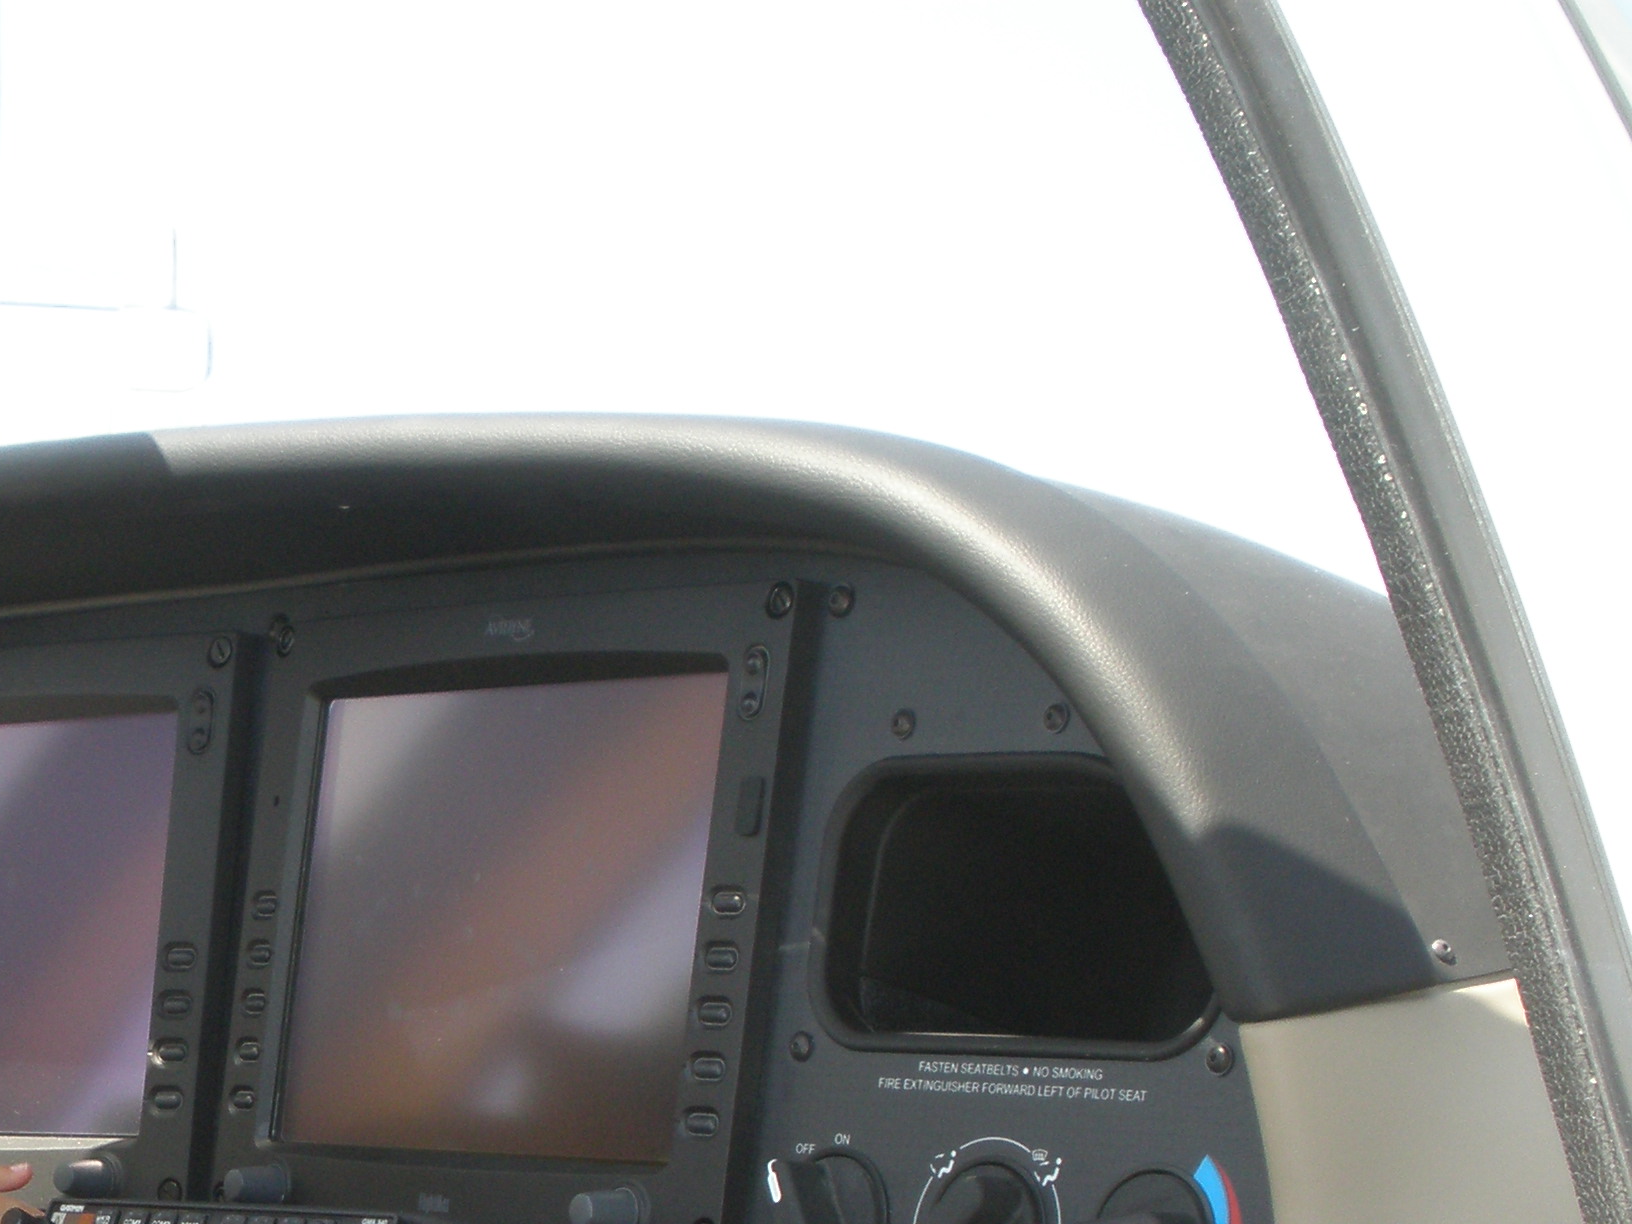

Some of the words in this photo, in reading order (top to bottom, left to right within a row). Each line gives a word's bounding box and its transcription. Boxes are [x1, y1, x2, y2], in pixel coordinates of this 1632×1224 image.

[918, 1060, 959, 1074] FASTEN
[960, 1062, 1020, 1077] SEATBELTS
[1032, 1065, 1049, 1078] NO
[1051, 1066, 1104, 1081] SMOKING
[878, 1077, 901, 1090] FIRE
[903, 1078, 980, 1094] EXTINGUISHER
[982, 1081, 1036, 1097] FORWARD
[1037, 1085, 1065, 1097] LEFT
[1066, 1086, 1082, 1099] OF
[1083, 1087, 1117, 1100] PILOT
[1118, 1089, 1148, 1102] SEAT
[834, 1132, 851, 1146] ON
[795, 1142, 816, 1155] OFF
